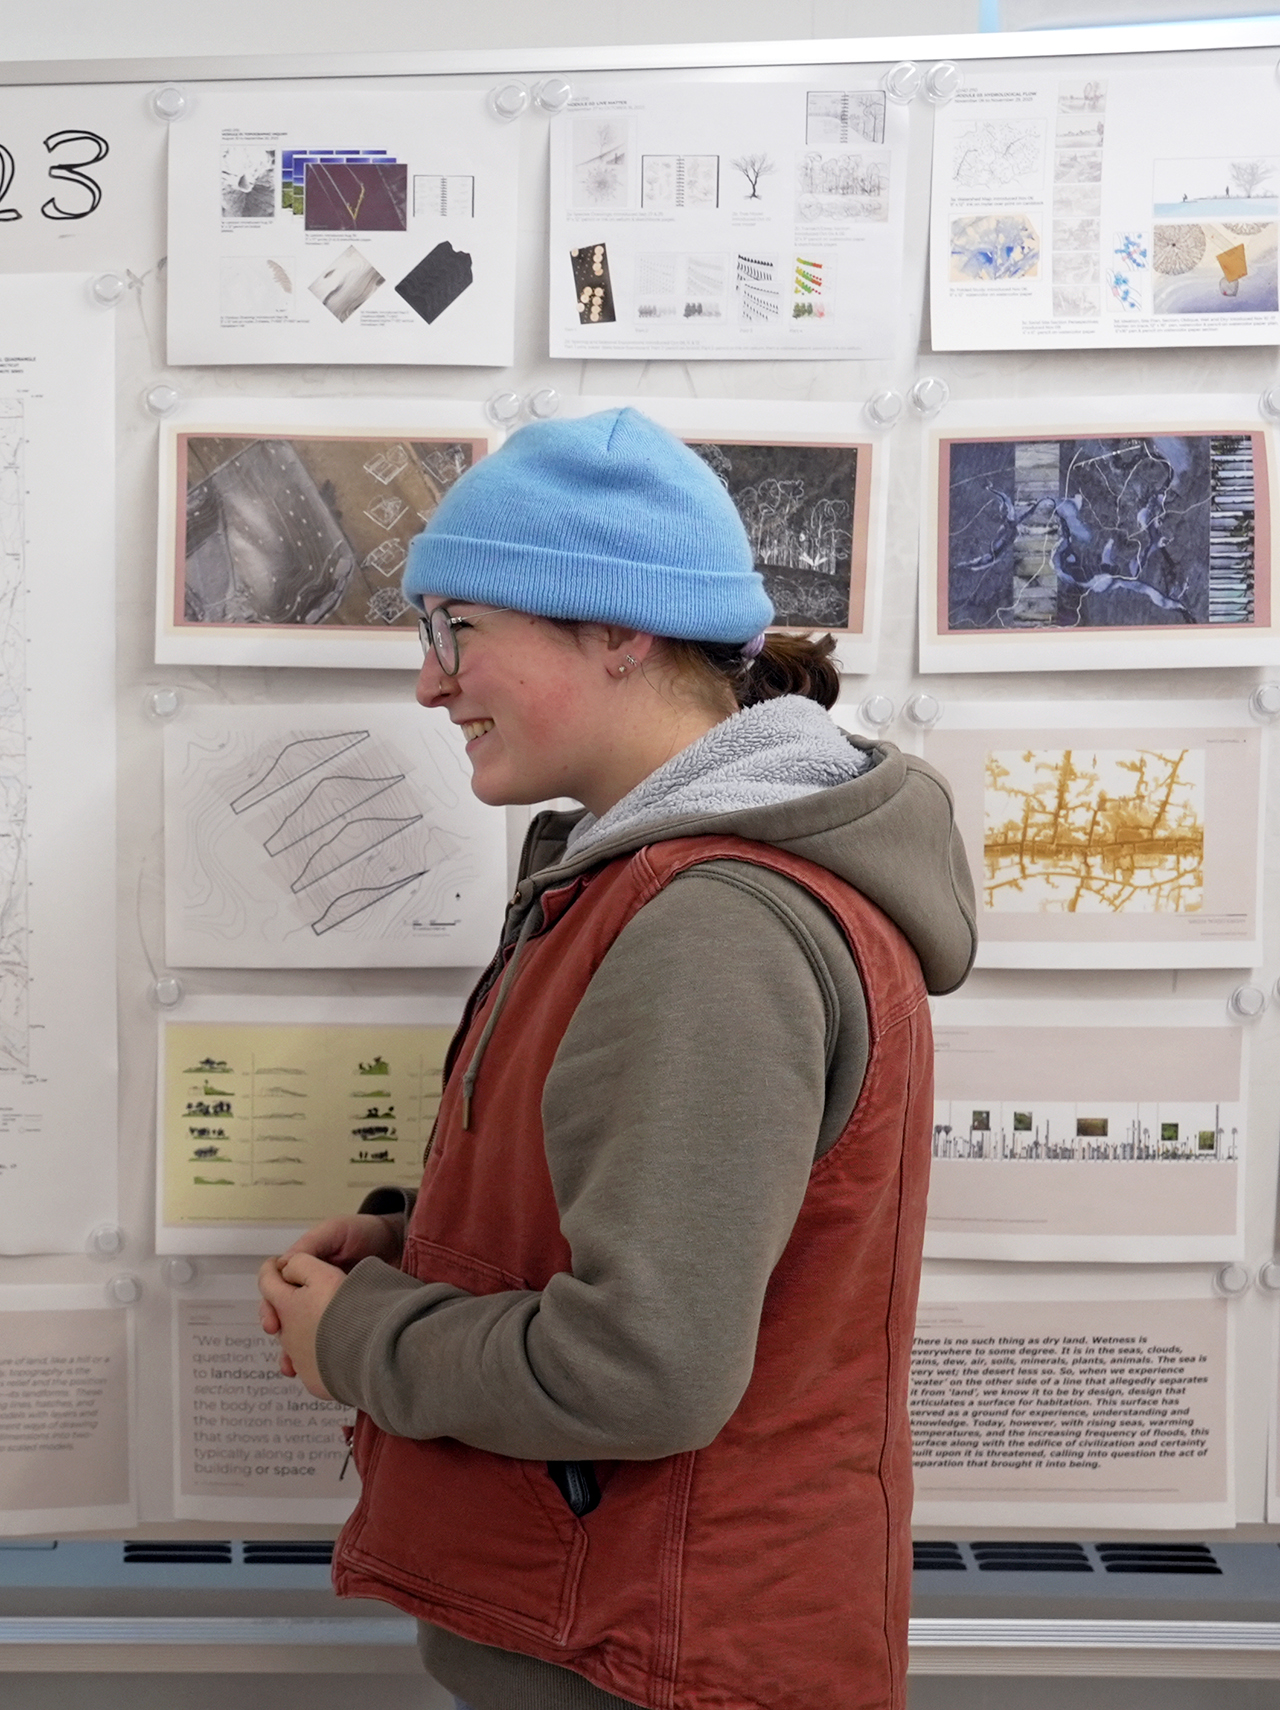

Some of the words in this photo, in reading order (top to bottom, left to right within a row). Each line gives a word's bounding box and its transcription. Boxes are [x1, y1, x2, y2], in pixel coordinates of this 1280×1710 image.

[225, 1336, 266, 1348] begin
[943, 1336, 953, 1345] is
[971, 1336, 995, 1344] such
[998, 1336, 1025, 1347] thing
[1042, 1336, 1060, 1346] dry
[1062, 1336, 1089, 1344] land.
[1092, 1336, 1136, 1344] Wetness
[1138, 1335, 1148, 1344] is
[912, 1347, 972, 1357] everywhere
[975, 1347, 986, 1355] to
[1018, 1346, 1059, 1357] degree.
[1061, 1346, 1070, 1354] It
[1073, 1346, 1082, 1354] is
[1085, 1346, 1095, 1354] in
[1098, 1346, 1115, 1354] the
[1118, 1348, 1144, 1356] seas,
[1147, 1345, 1183, 1356] clouds,
[911, 1357, 940, 1368] rains,
[943, 1357, 968, 1367] dew,
[971, 1357, 988, 1367] air,
[991, 1357, 1018, 1367] soils,
[1020, 1356, 1069, 1367] minerals,
[1072, 1356, 1108, 1366] plants,
[1110, 1355, 1155, 1363] animals.
[1158, 1355, 1176, 1363] The
[1198, 1354, 1207, 1362] is
[193, 1368, 206, 1378] to
[910, 1370, 933, 1378] very
[962, 1367, 980, 1375] the
[982, 1367, 1015, 1375] desert
[1017, 1366, 1038, 1375] less
[1059, 1366, 1076, 1377] So,
[1079, 1366, 1107, 1374] when
[1128, 1365, 1185, 1376] experience
[965, 1377, 983, 1385] the
[985, 1377, 1012, 1385] other
[1016, 1377, 1037, 1385] side
[1040, 1377, 1051, 1385] of
[1063, 1376, 1082, 1385] line
[1084, 1376, 1106, 1384] that
[1109, 1376, 1156, 1386] allegedly
[1159, 1375, 1208, 1386] separates
[247, 1384, 304, 1397] typically
[910, 1387, 918, 1396] it
[920, 1387, 946, 1396] from
[1000, 1387, 1029, 1395] know
[1032, 1387, 1040, 1395] it
[1042, 1387, 1054, 1395] to
[1056, 1387, 1069, 1395] be
[1072, 1387, 1085, 1398] by
[1087, 1387, 1125, 1397] design,
[1128, 1386, 1162, 1397] design
[1165, 1386, 1186, 1394] that
[194, 1400, 216, 1410] the
[221, 1400, 257, 1413] body
[259, 1400, 271, 1410] of
[910, 1398, 966, 1406] articulates
[977, 1398, 1016, 1406] surface
[1018, 1397, 1033, 1406] for
[1036, 1397, 1093, 1405] habitation.
[1097, 1397, 1118, 1405] This
[1120, 1397, 1159, 1405] surface
[1161, 1396, 1180, 1405] has
[910, 1408, 945, 1416] served
[971, 1408, 1009, 1419] ground
[1011, 1408, 1026, 1416] for
[1029, 1408, 1090, 1419] experience,
[1092, 1407, 1168, 1418] understanding
[1170, 1407, 1190, 1415] and
[194, 1416, 216, 1426] the
[221, 1416, 272, 1426] horizon
[308, 1416, 318, 1426] A
[910, 1418, 970, 1429] knowledge.
[973, 1418, 1007, 1429] Today,
[1009, 1418, 1058, 1429] however,
[1061, 1418, 1084, 1426] with
[1086, 1418, 1117, 1428] rising
[1119, 1420, 1146, 1428] seas,
[1149, 1417, 1194, 1428] warming
[194, 1432, 221, 1442] that
[226, 1432, 269, 1442] shows
[285, 1432, 335, 1442] vertical
[986, 1428, 1005, 1437] and
[1008, 1428, 1025, 1437] the
[1028, 1428, 1082, 1439] increasing
[1084, 1428, 1137, 1438] frequency
[1140, 1428, 1151, 1436] of
[1153, 1427, 1188, 1438] floods,
[1190, 1427, 1210, 1435] this
[194, 1448, 250, 1460] typically
[255, 1448, 292, 1460] along
[194, 1463, 252, 1476] building
[255, 1466, 269, 1474] or
[274, 1466, 315, 1477] space
